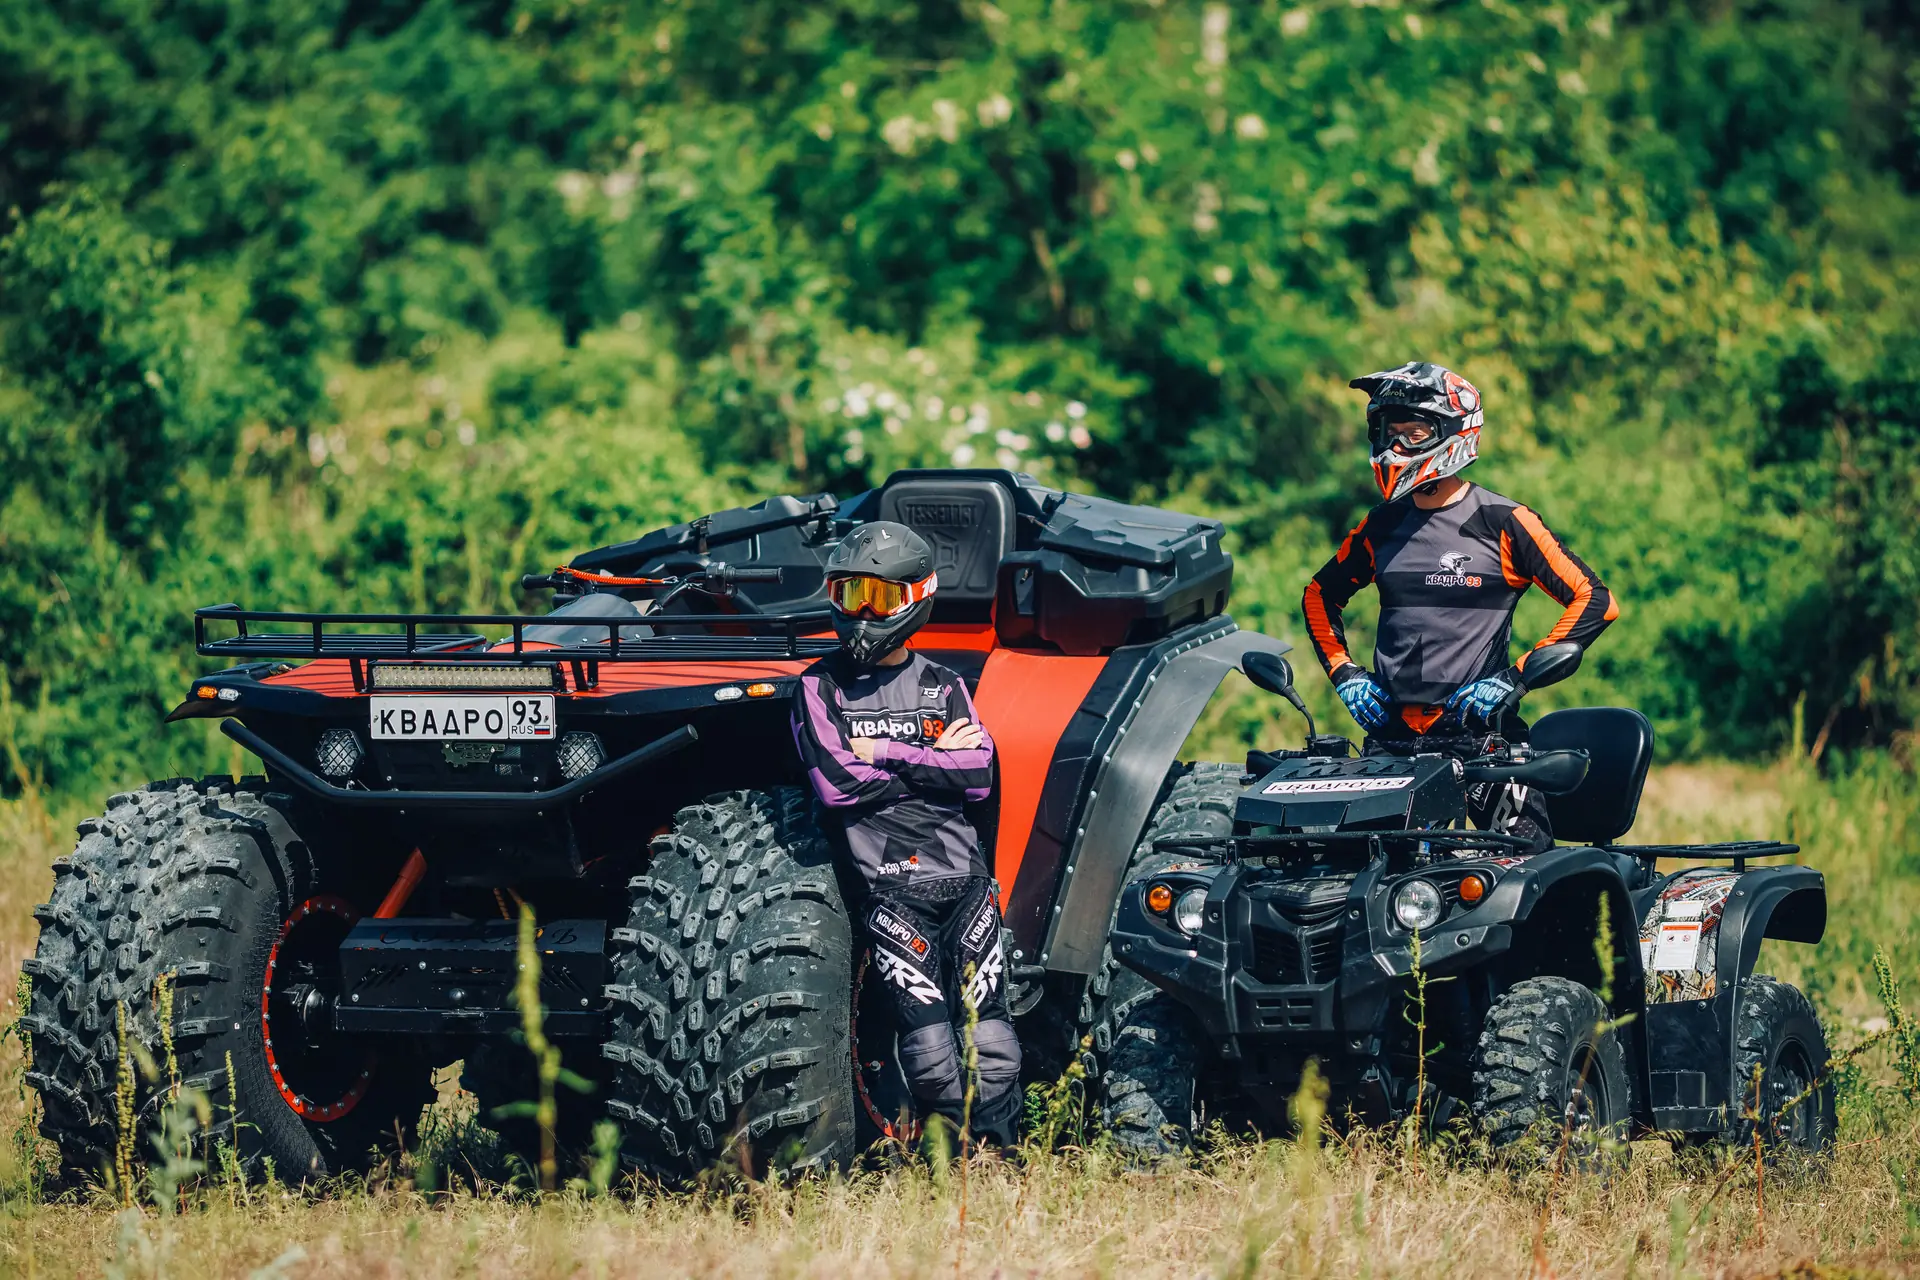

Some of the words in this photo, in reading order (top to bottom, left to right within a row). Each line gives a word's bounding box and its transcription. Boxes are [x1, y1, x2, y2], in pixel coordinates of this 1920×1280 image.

[380, 709, 504, 736] КВАДРО
[512, 700, 542, 726] 93
[511, 725, 534, 735] RUS
[923, 718, 945, 739] 93
[875, 911, 912, 941] КВАДРО
[911, 937, 927, 953] 93
